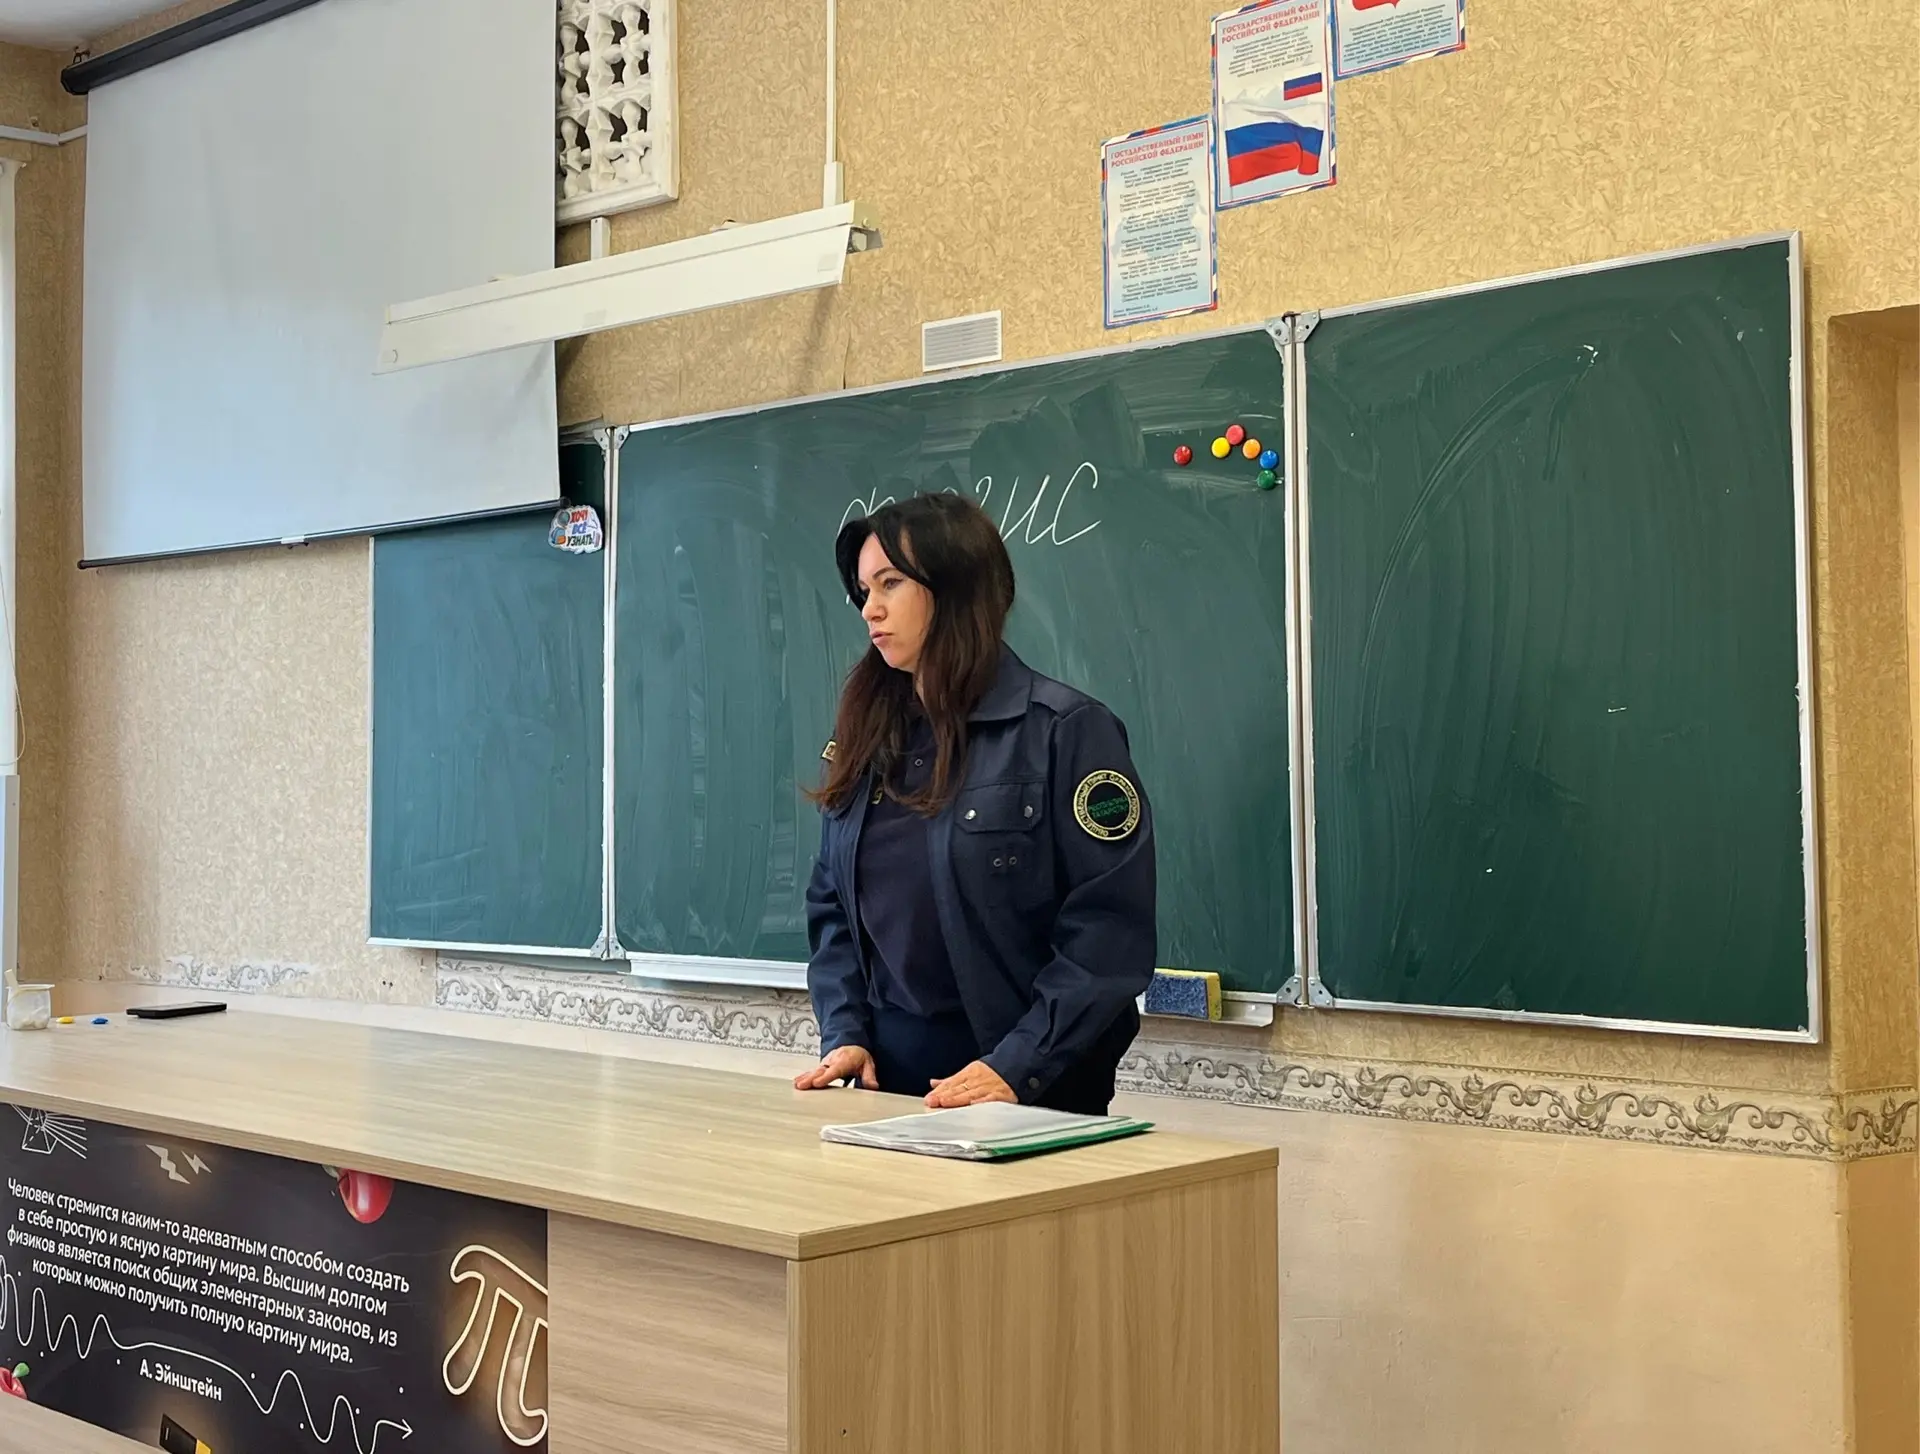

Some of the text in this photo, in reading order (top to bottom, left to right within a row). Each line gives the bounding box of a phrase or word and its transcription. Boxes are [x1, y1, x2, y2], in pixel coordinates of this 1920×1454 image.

[1221, 10, 1320, 44] РОССИЙСКОЙ ФЕДЕРАЦИИ
[1222, 1, 1319, 34] ГОСУДАРСТВЕННЫЙ ФЛАГ
[1111, 131, 1204, 159] ГОСУДАРСТВЕННЫЙ ГИМН
[1111, 140, 1204, 168] РОССИЙСКОЙ ФЕДЕРАЦИИ
[8, 1177, 410, 1293] Человек стремится каким-то адекватным способом создать
[18, 1208, 387, 1316] в себе простую и ясную картину мира. Высшим долгом
[7, 1224, 398, 1347] физиков является поиск общих элементарных законов, из
[32, 1259, 353, 1363] которых можно получить полную картину мира.
[140, 1359, 222, 1401] А. Эйнштейн
